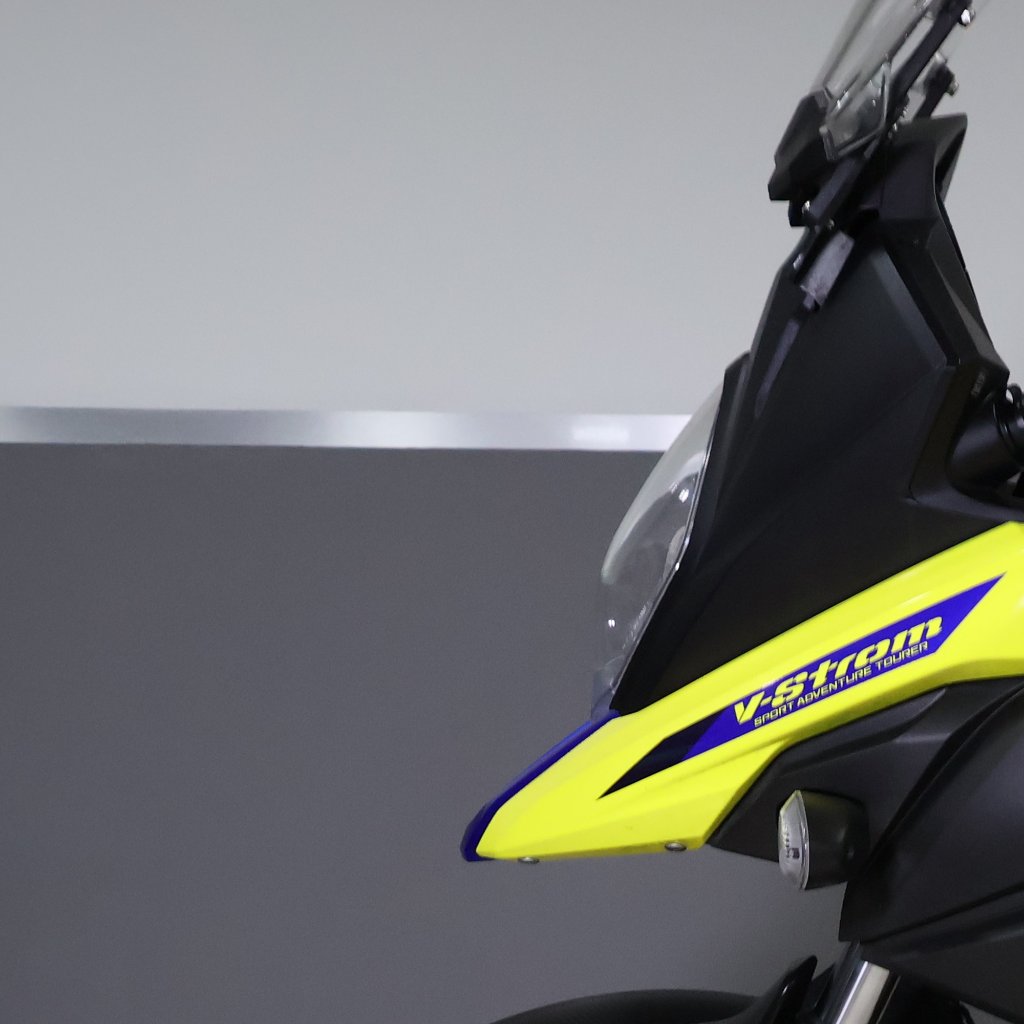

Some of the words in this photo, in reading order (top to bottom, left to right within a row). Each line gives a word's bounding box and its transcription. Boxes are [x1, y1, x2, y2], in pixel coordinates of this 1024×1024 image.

[754, 700, 795, 727] SPORT
[797, 665, 872, 707] ADVENTURE
[875, 640, 928, 671] TOURER
